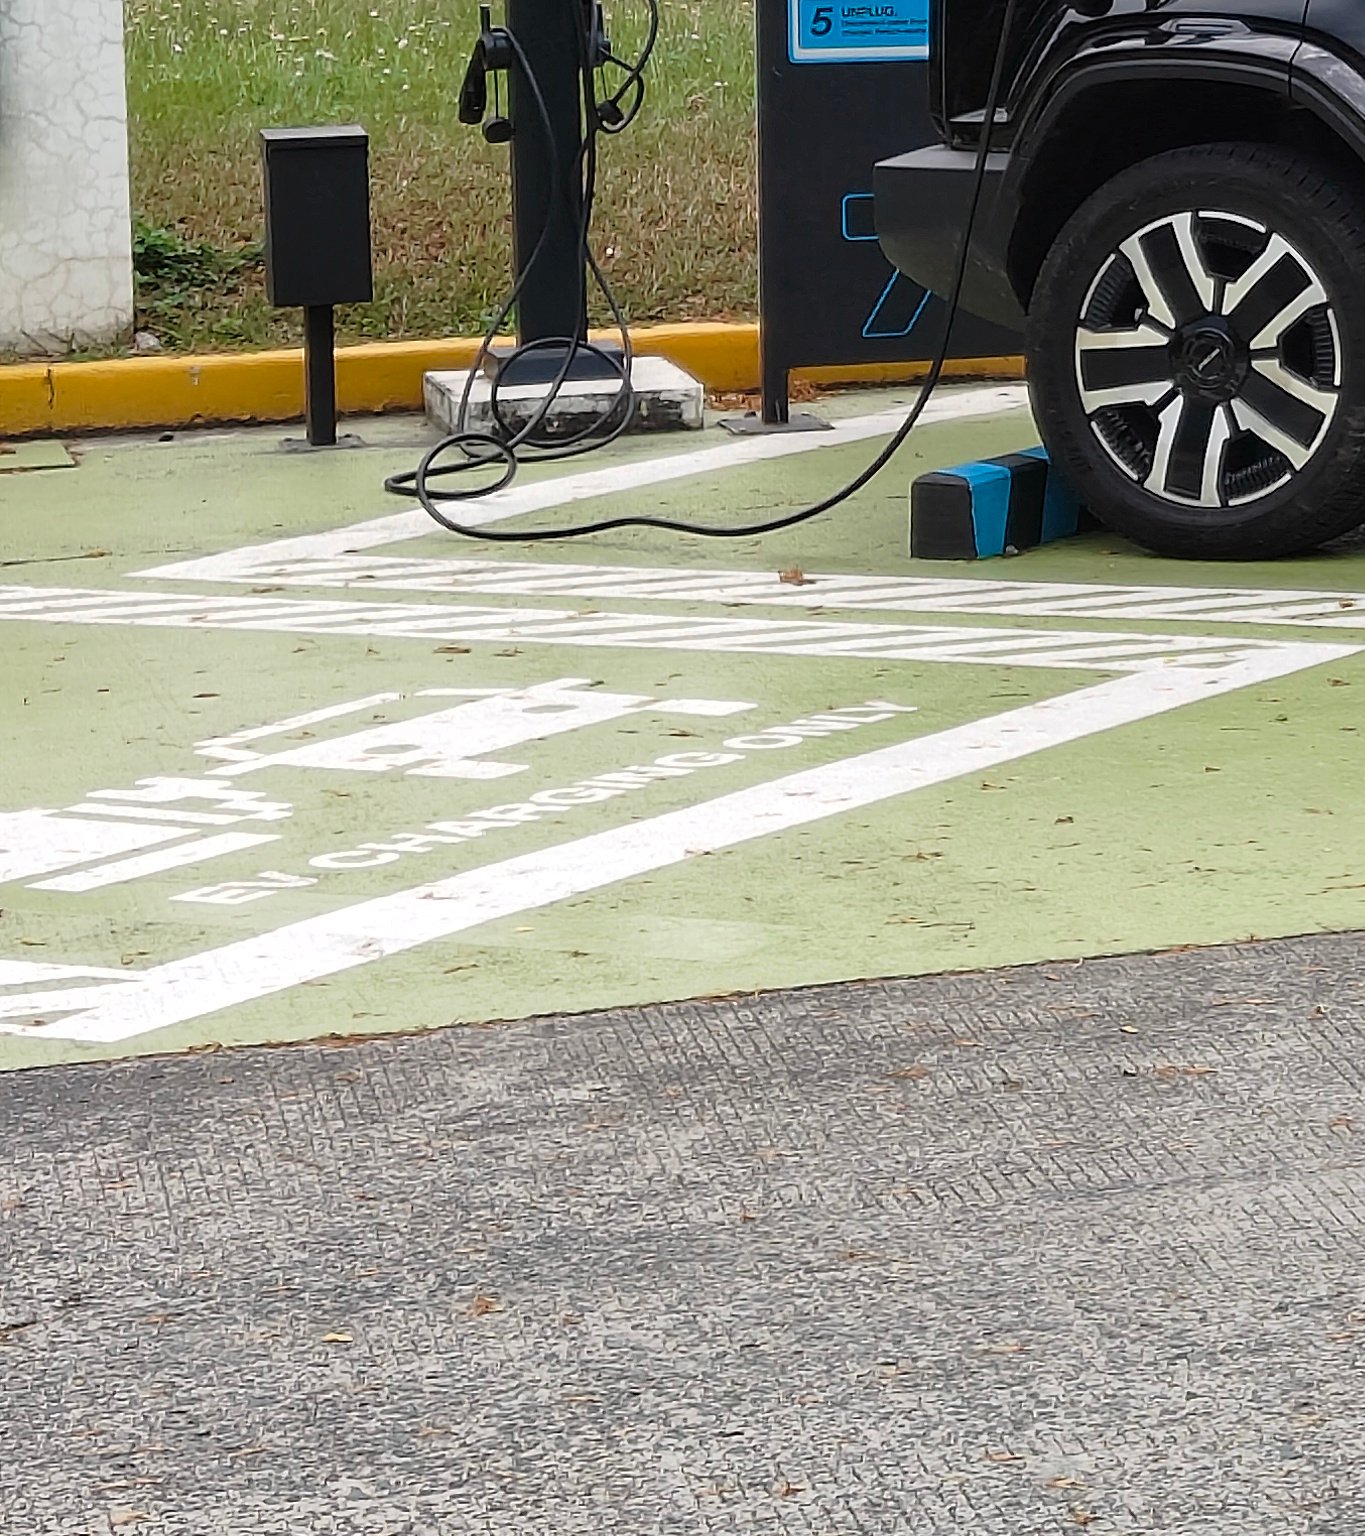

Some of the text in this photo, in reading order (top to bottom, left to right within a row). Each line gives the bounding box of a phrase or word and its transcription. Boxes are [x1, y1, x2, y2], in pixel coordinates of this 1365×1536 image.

[810, 7, 833, 36] 5
[168, 701, 918, 904] EV CHARGING ONLY
